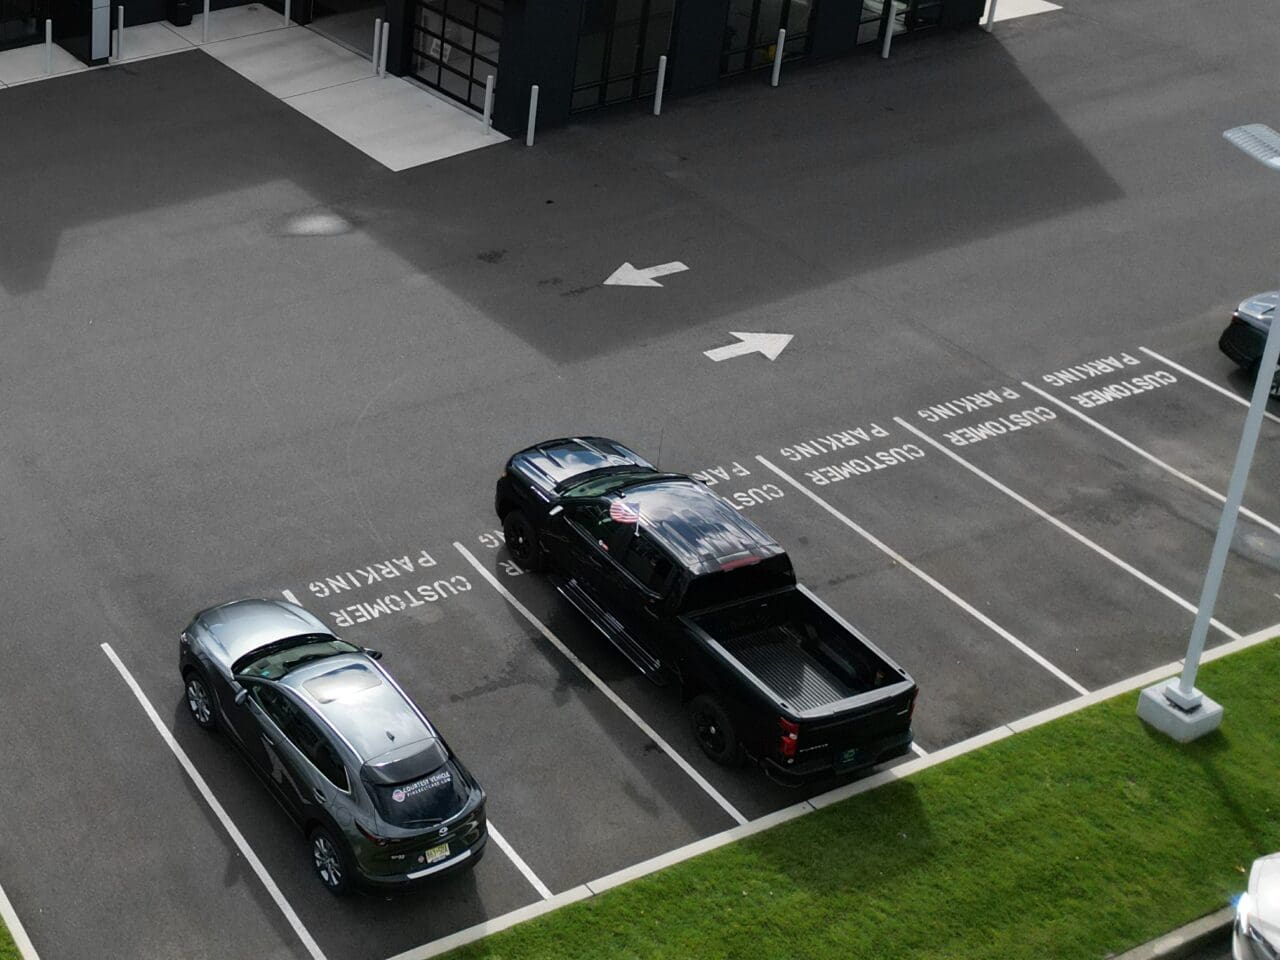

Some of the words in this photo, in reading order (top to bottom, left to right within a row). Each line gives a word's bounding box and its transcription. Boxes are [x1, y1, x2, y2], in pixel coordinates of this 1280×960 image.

[1042, 352, 1141, 387] PARKING
[917, 386, 1020, 423] PARKING
[1070, 370, 1178, 408] CUSTOMER
[780, 423, 890, 461] PARKING
[942, 406, 1057, 446] CUSTOMER
[804, 443, 926, 486] CUSTOMER
[309, 550, 437, 598] PARKING
[329, 575, 472, 627] CUSTOMER
[402, 776, 429, 793] COURTESY
[430, 771, 451, 783] VEHICLE
